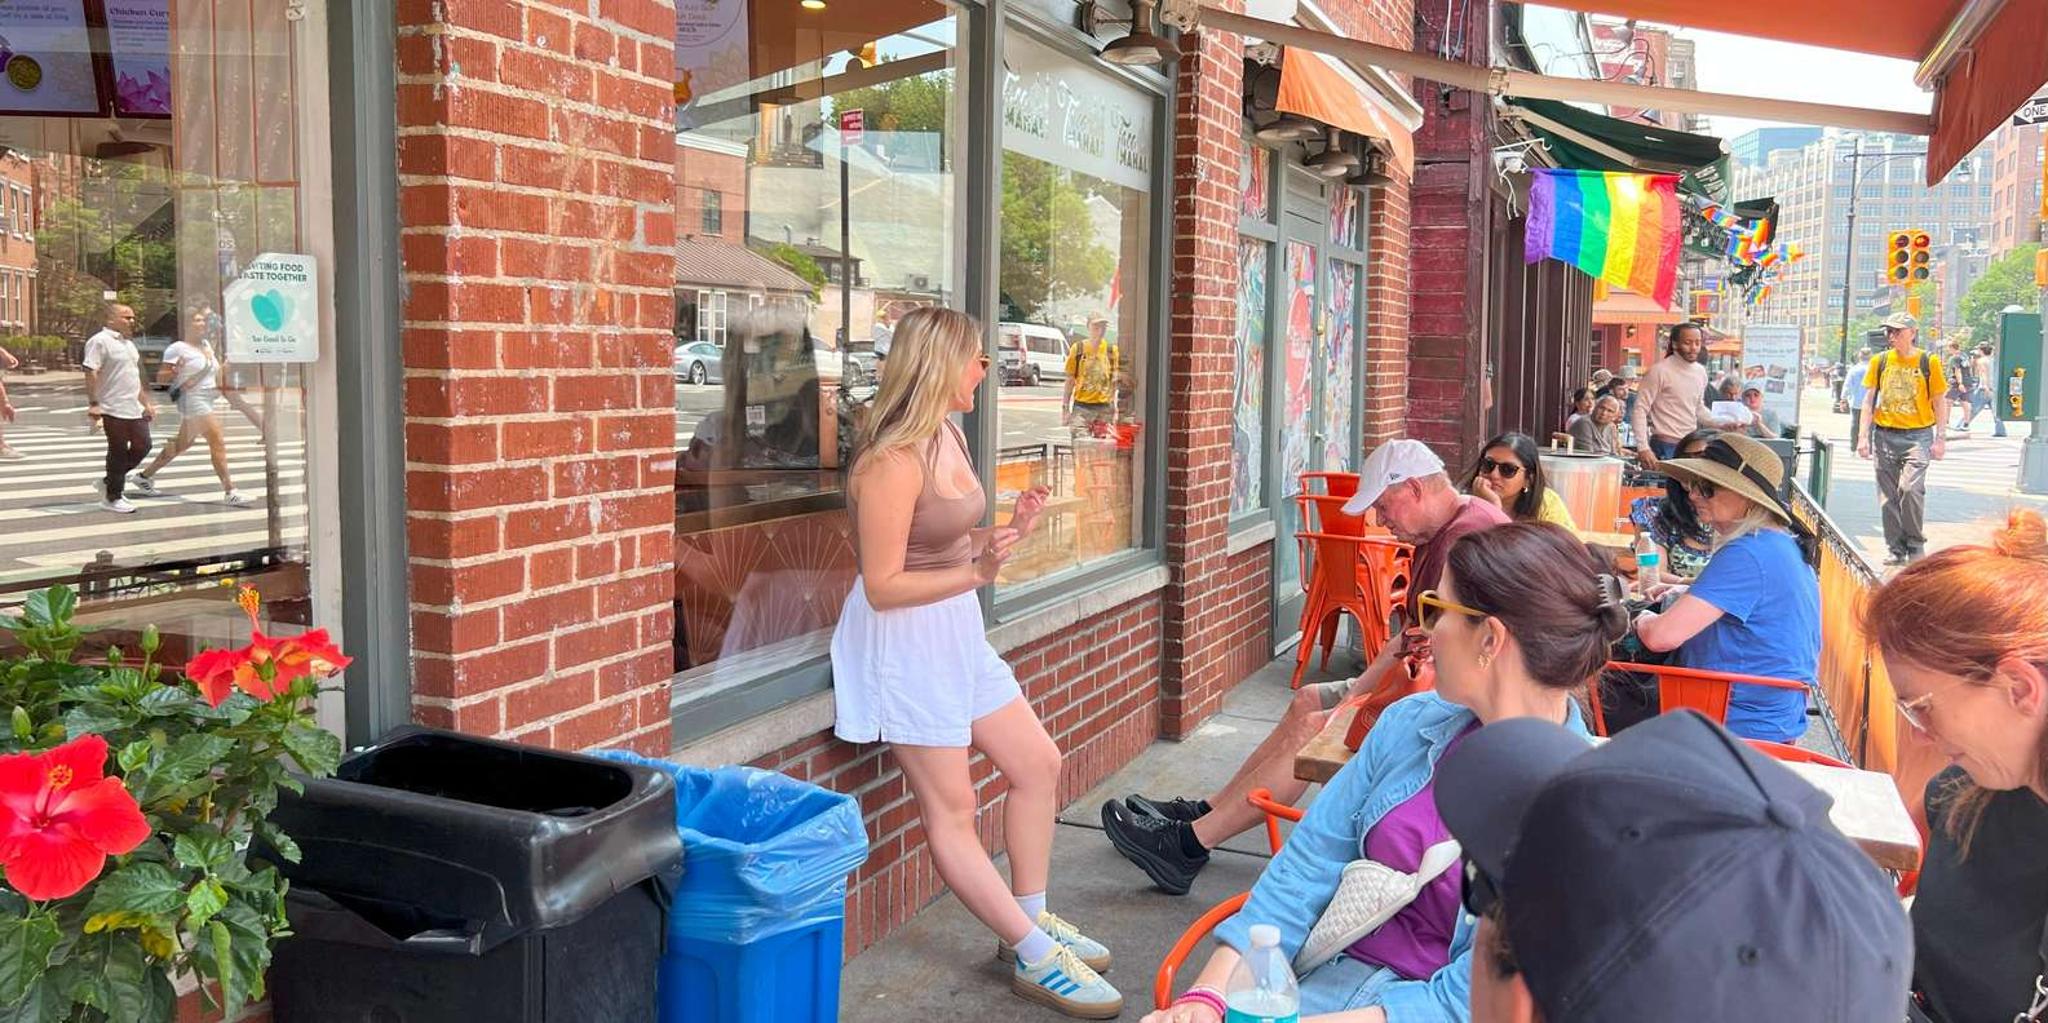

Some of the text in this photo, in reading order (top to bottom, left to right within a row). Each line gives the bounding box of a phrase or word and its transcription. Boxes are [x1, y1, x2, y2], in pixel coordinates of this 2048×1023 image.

[2024, 105, 2047, 118] ONE
[280, 263, 304, 272] FOOD
[266, 272, 307, 282] TOGETHER
